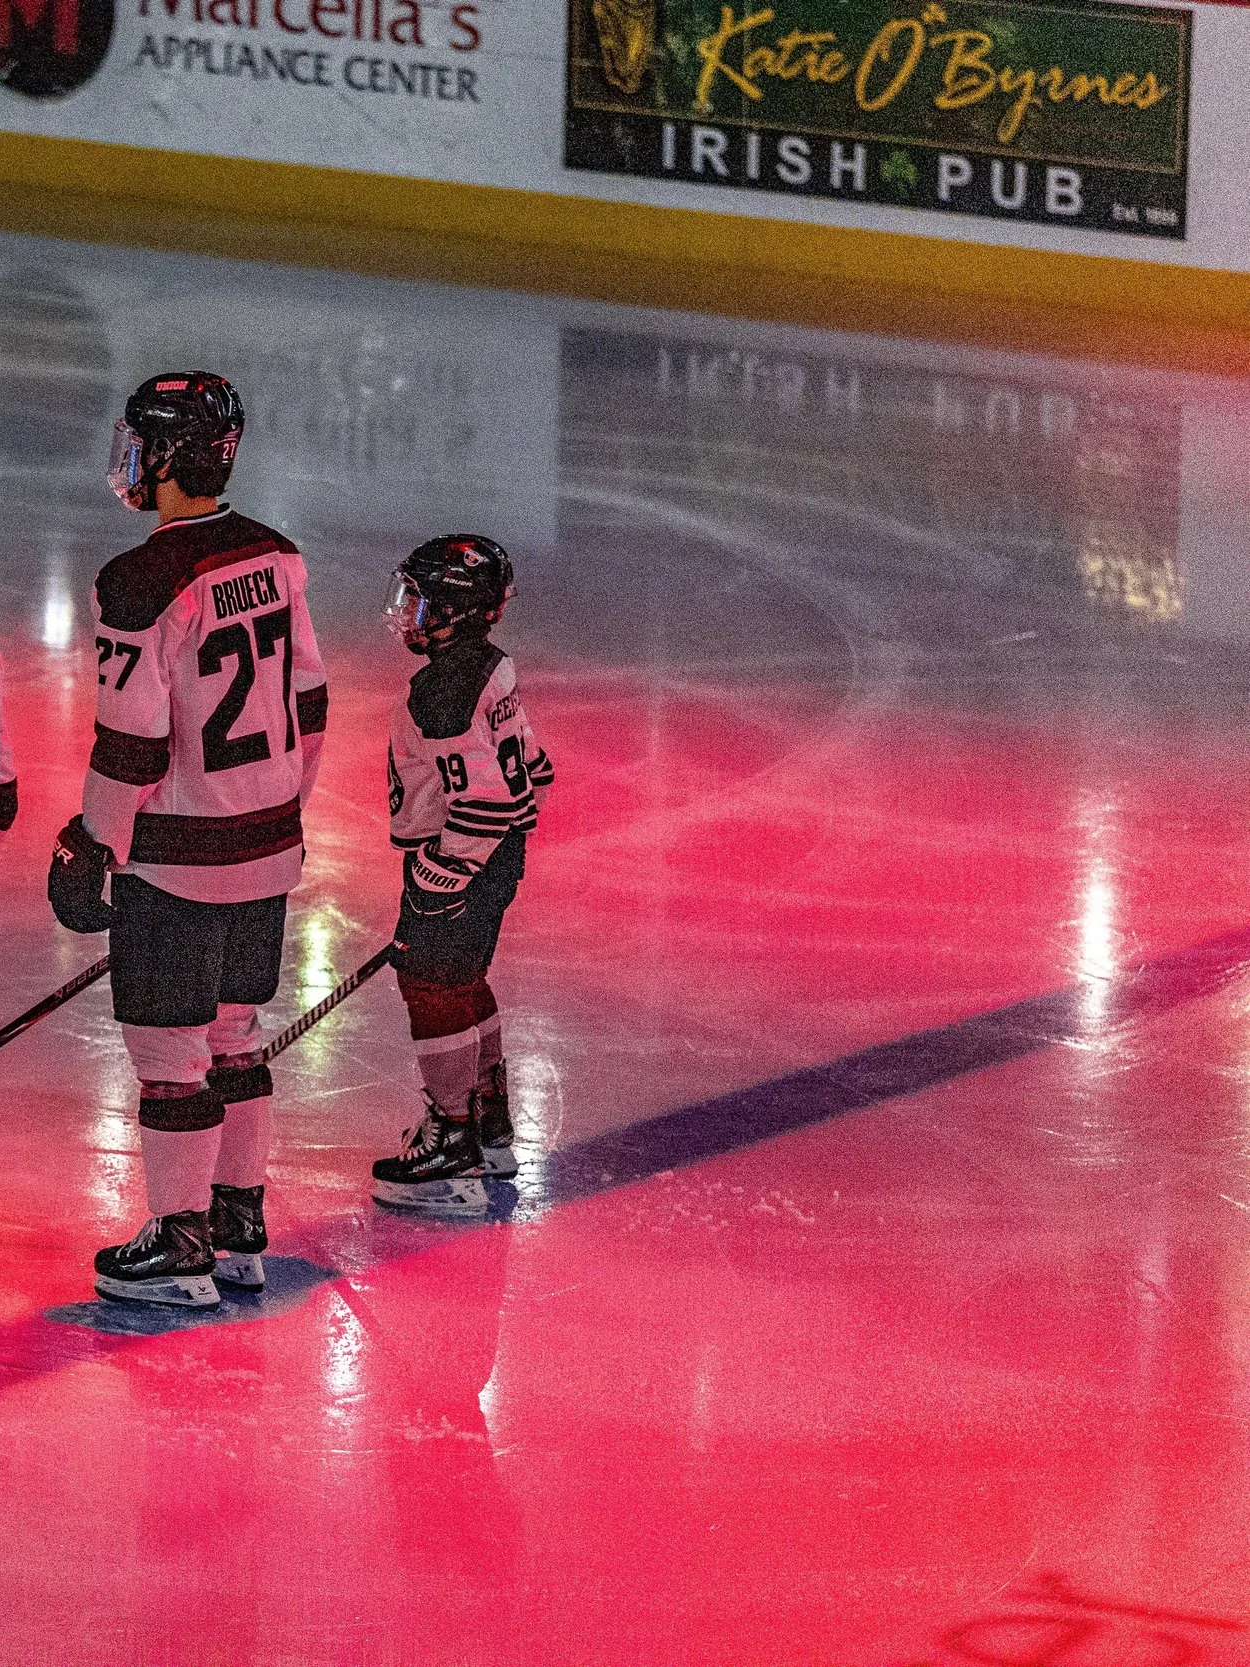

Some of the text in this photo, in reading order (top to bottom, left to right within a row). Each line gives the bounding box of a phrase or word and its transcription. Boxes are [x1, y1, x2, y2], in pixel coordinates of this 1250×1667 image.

[129, 35, 482, 103] APPLIANCE CENTER
[696, 6, 848, 105] Katie
[662, 122, 1084, 217] IRISH PUB
[222, 442, 237, 460] 27
[211, 566, 281, 620] BRUECK
[95, 635, 143, 691] 27
[198, 606, 296, 774] 27
[412, 860, 460, 890] RRIOR
